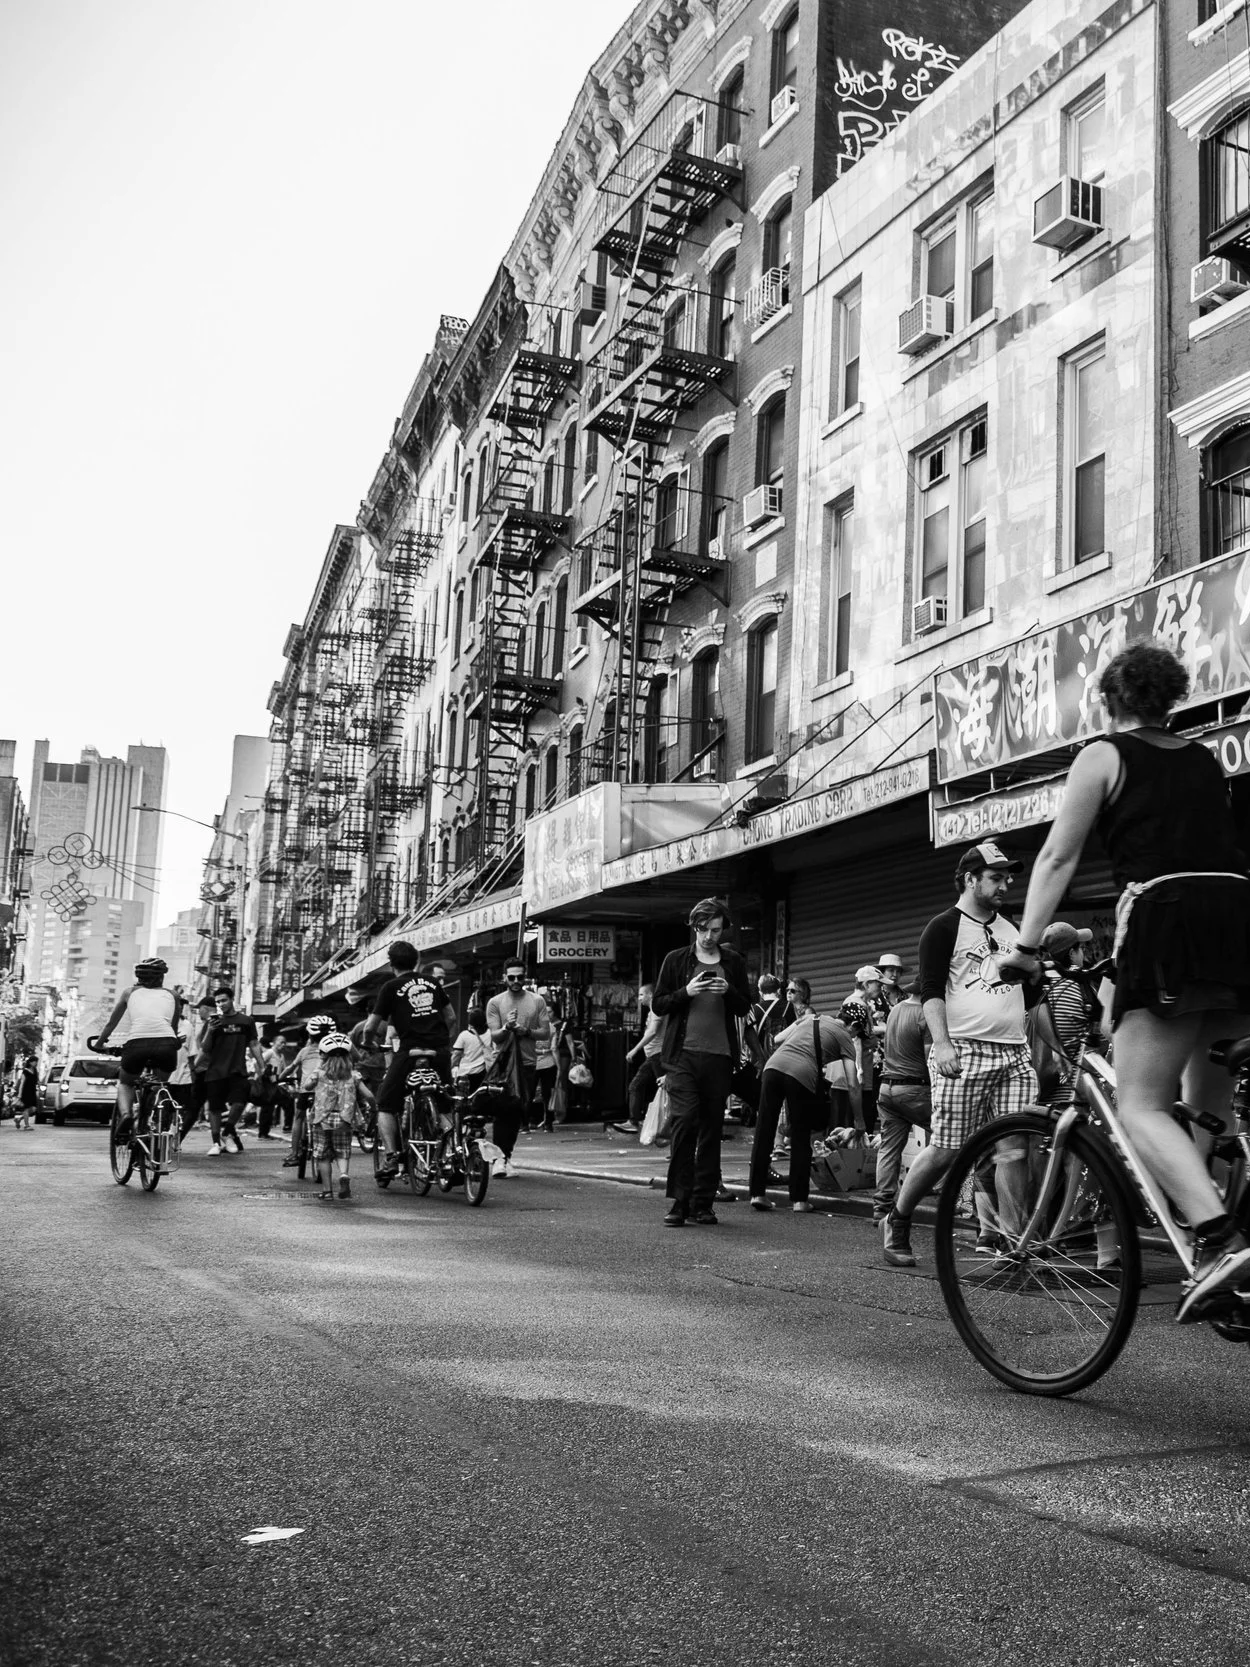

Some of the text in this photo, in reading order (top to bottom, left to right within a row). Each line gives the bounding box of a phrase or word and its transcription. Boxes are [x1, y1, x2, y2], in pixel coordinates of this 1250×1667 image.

[779, 799, 821, 836] TRADING
[824, 788, 853, 818] CORP.
[965, 808, 987, 834] Tel:
[989, 798, 1021, 828] (212)
[1023, 786, 1068, 820] 226-7
[548, 929, 611, 943] 食品 日用品
[548, 947, 609, 957] GROCERY
[981, 983, 1014, 995] TAYLO
